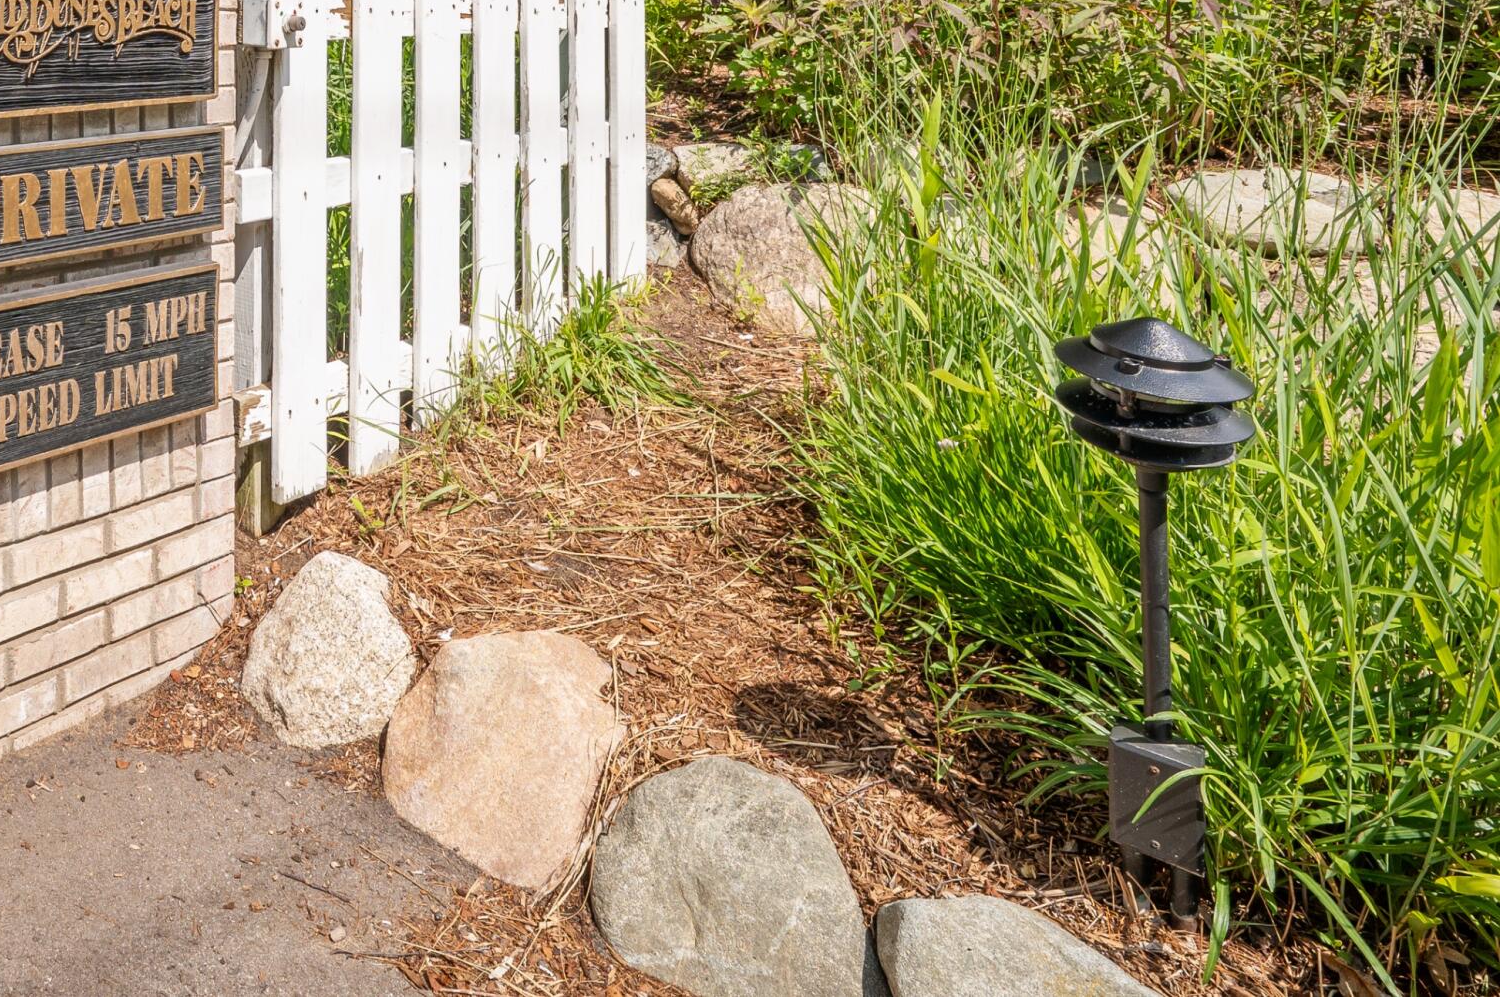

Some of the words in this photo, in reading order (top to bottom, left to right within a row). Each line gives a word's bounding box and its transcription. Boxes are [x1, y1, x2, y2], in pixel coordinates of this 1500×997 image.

[104, 305, 132, 354] 15
[143, 291, 208, 346] MPH
[94, 354, 179, 416] LIMIT
